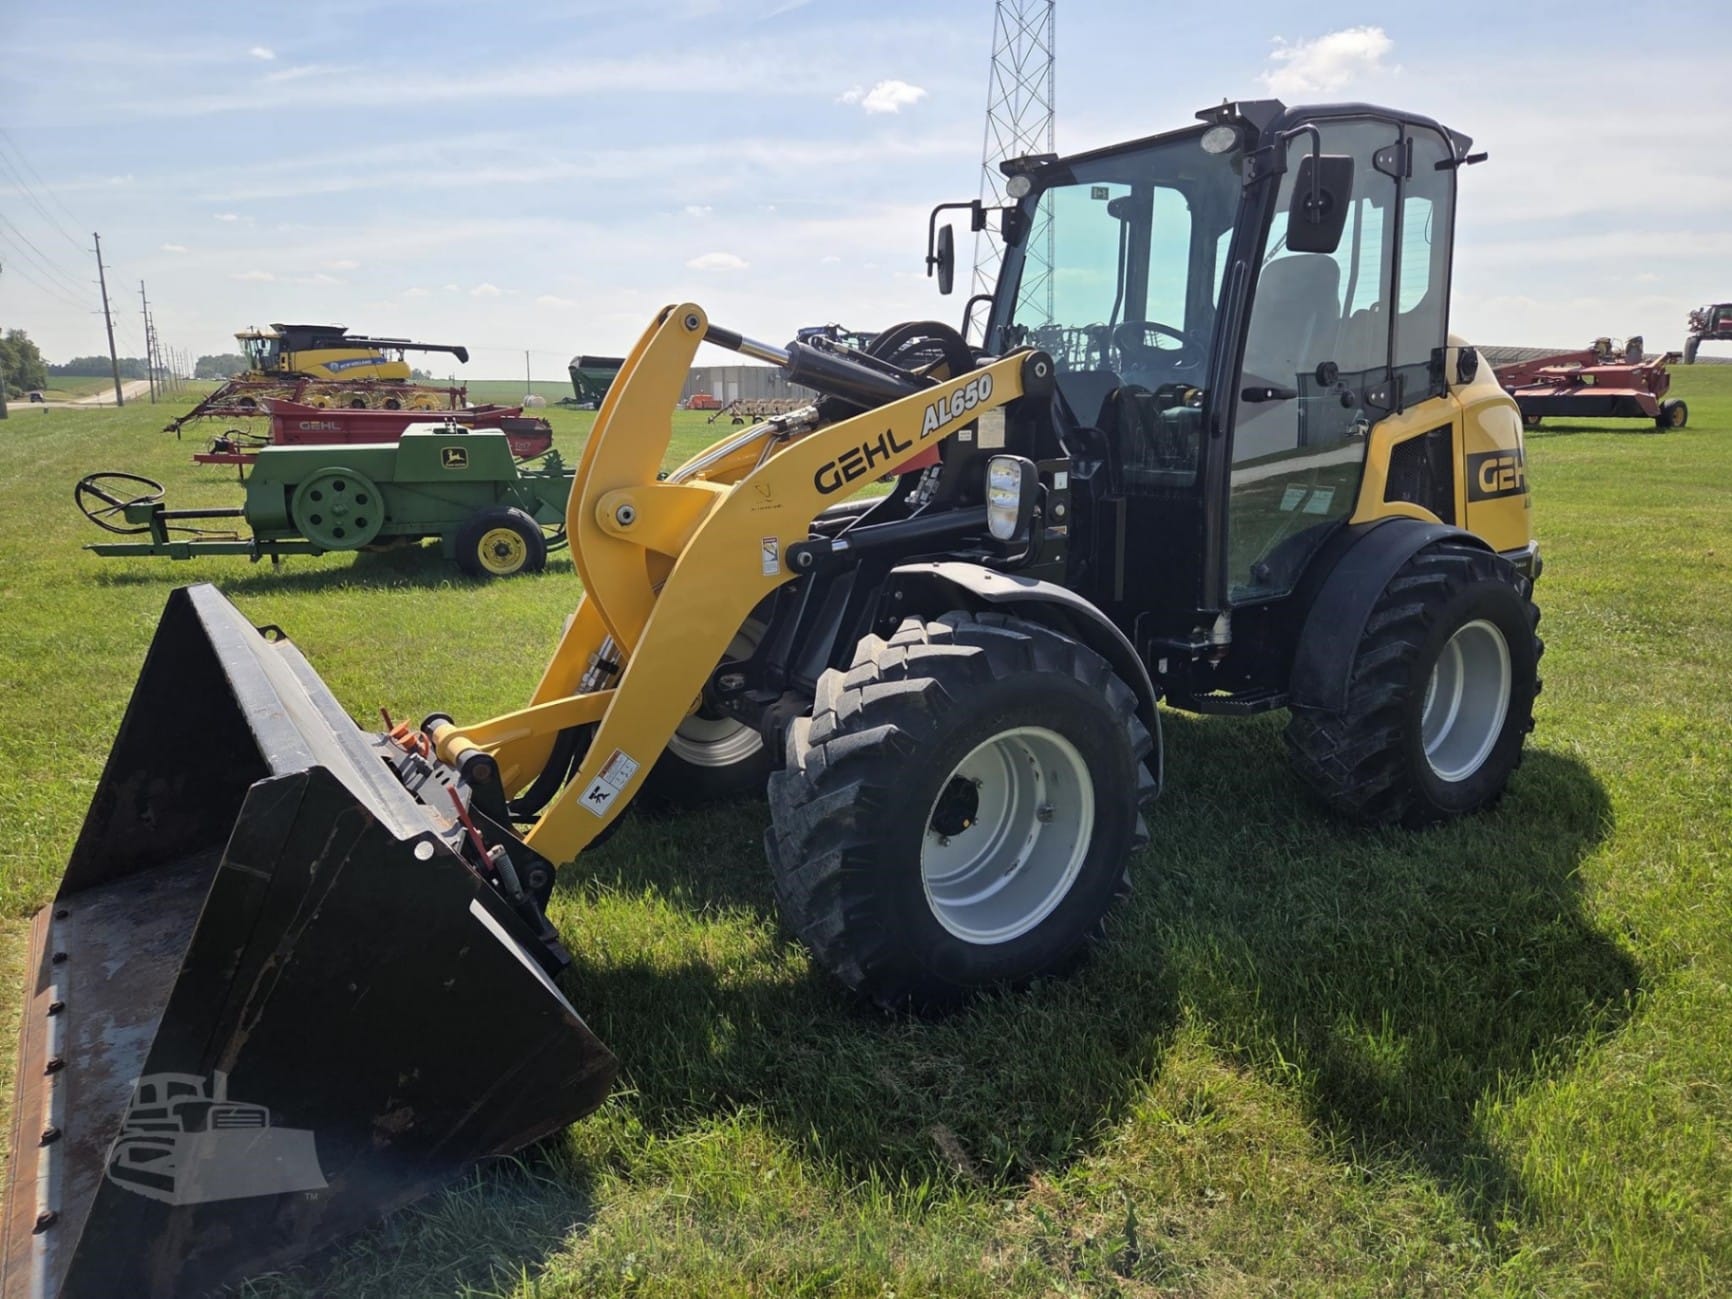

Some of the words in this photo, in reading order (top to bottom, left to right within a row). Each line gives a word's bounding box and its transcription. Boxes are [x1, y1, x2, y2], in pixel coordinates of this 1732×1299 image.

[299, 421, 342, 430] GEHL
[814, 429, 913, 495] GEHL
[920, 373, 993, 440] AL650
[1479, 456, 1523, 493] GEH
